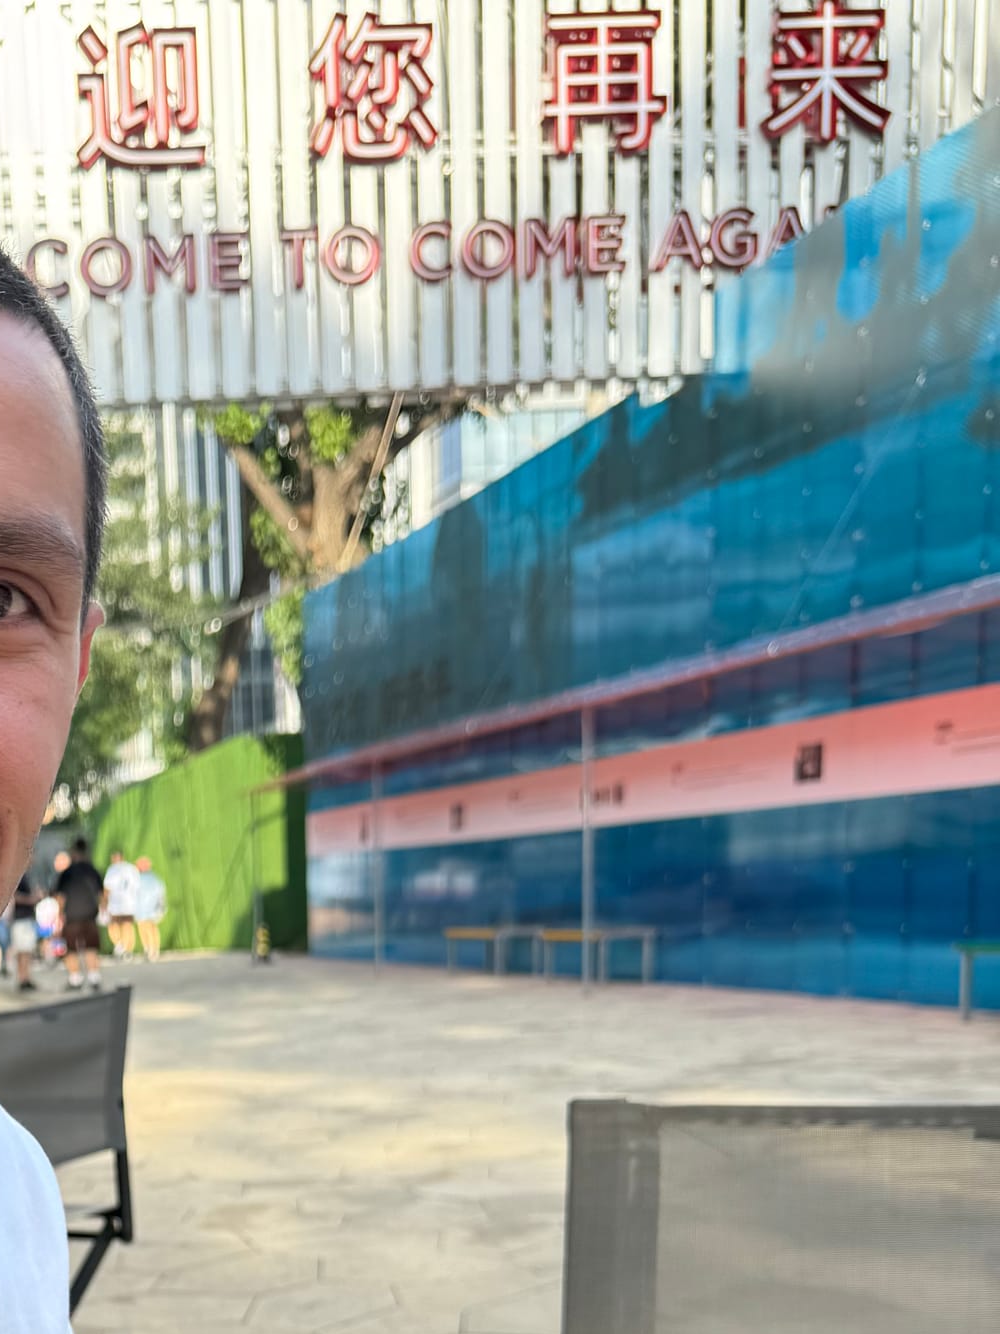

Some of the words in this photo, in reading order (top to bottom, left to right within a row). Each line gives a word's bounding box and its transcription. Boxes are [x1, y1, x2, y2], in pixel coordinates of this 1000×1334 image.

[281, 226, 382, 290] TO
[410, 213, 626, 282] COME
[649, 206, 839, 272] AGA
